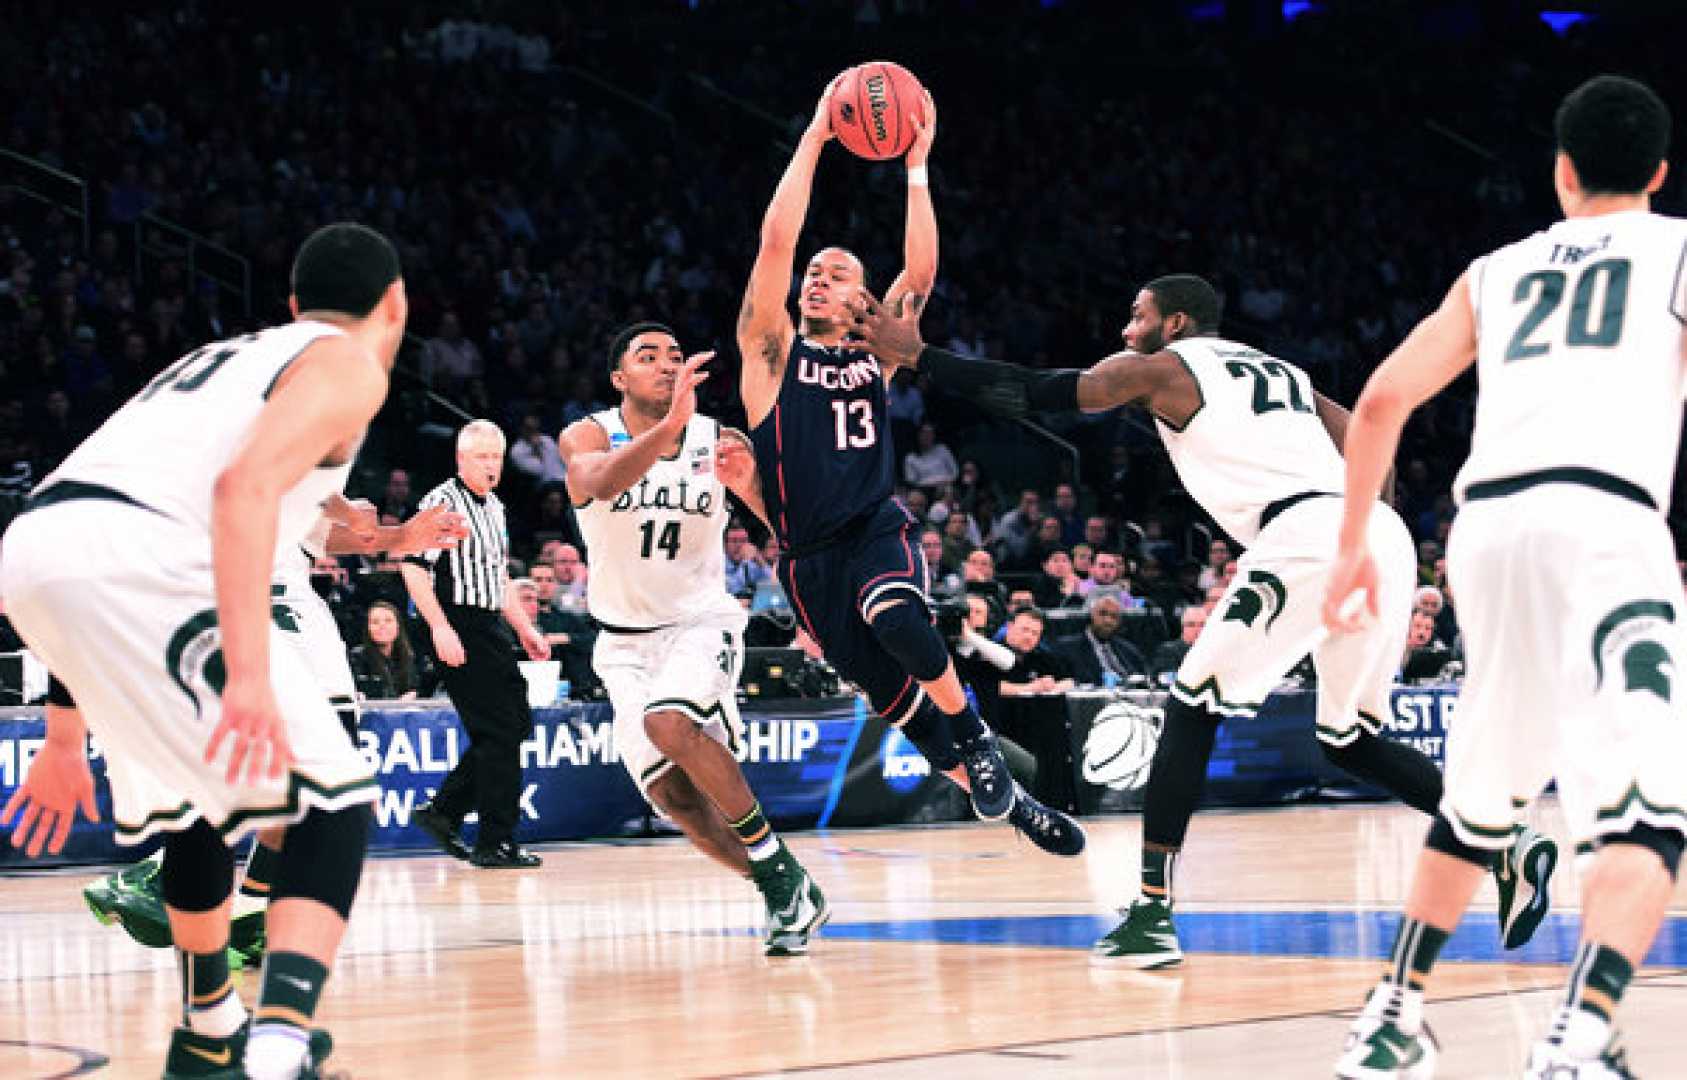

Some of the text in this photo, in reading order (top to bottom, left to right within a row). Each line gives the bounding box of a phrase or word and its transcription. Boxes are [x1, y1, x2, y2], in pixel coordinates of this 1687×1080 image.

[1504, 258, 1632, 363] 20
[1226, 359, 1314, 416] 22
[831, 399, 876, 451] 13
[638, 519, 682, 560] 14
